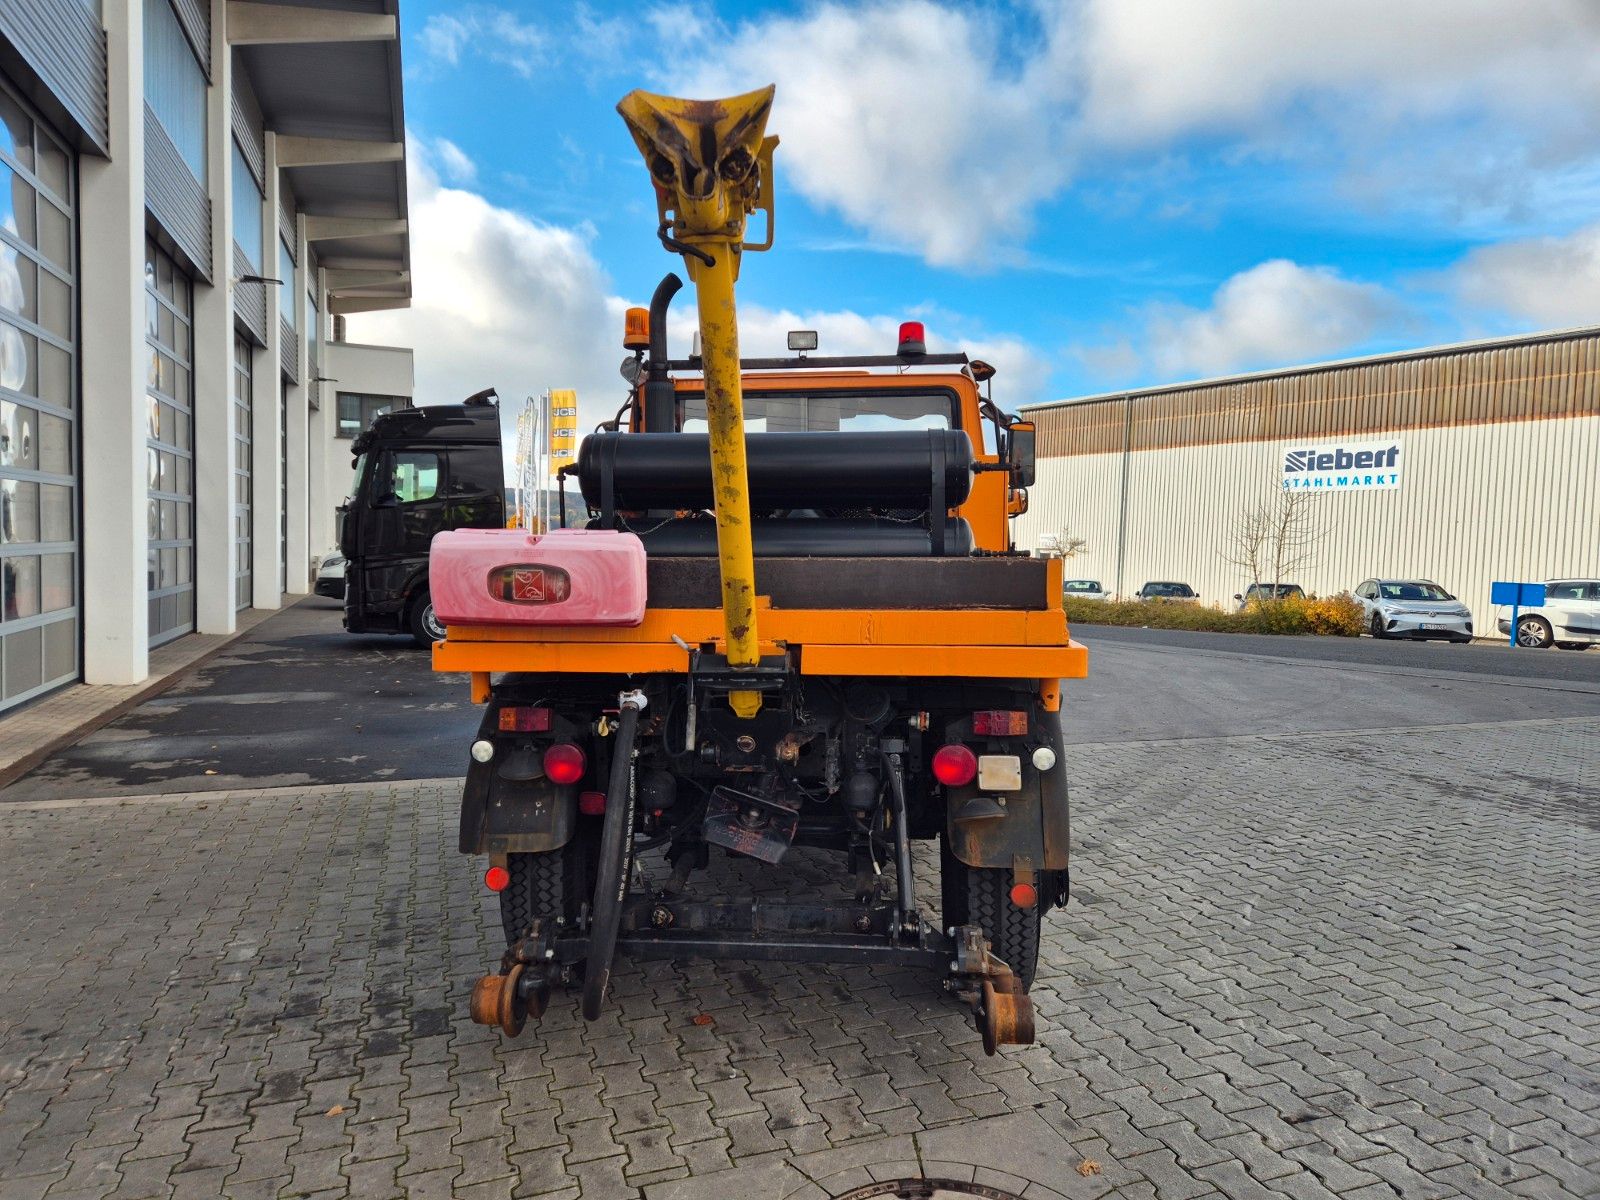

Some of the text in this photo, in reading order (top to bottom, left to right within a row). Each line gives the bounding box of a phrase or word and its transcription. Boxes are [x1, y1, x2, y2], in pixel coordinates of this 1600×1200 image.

[552, 407, 576, 416] JCB
[552, 428, 576, 437] JCB
[551, 449, 575, 457] JCB
[1285, 445, 1399, 472] Siebert
[1283, 474, 1398, 488] STAHLMARKT
